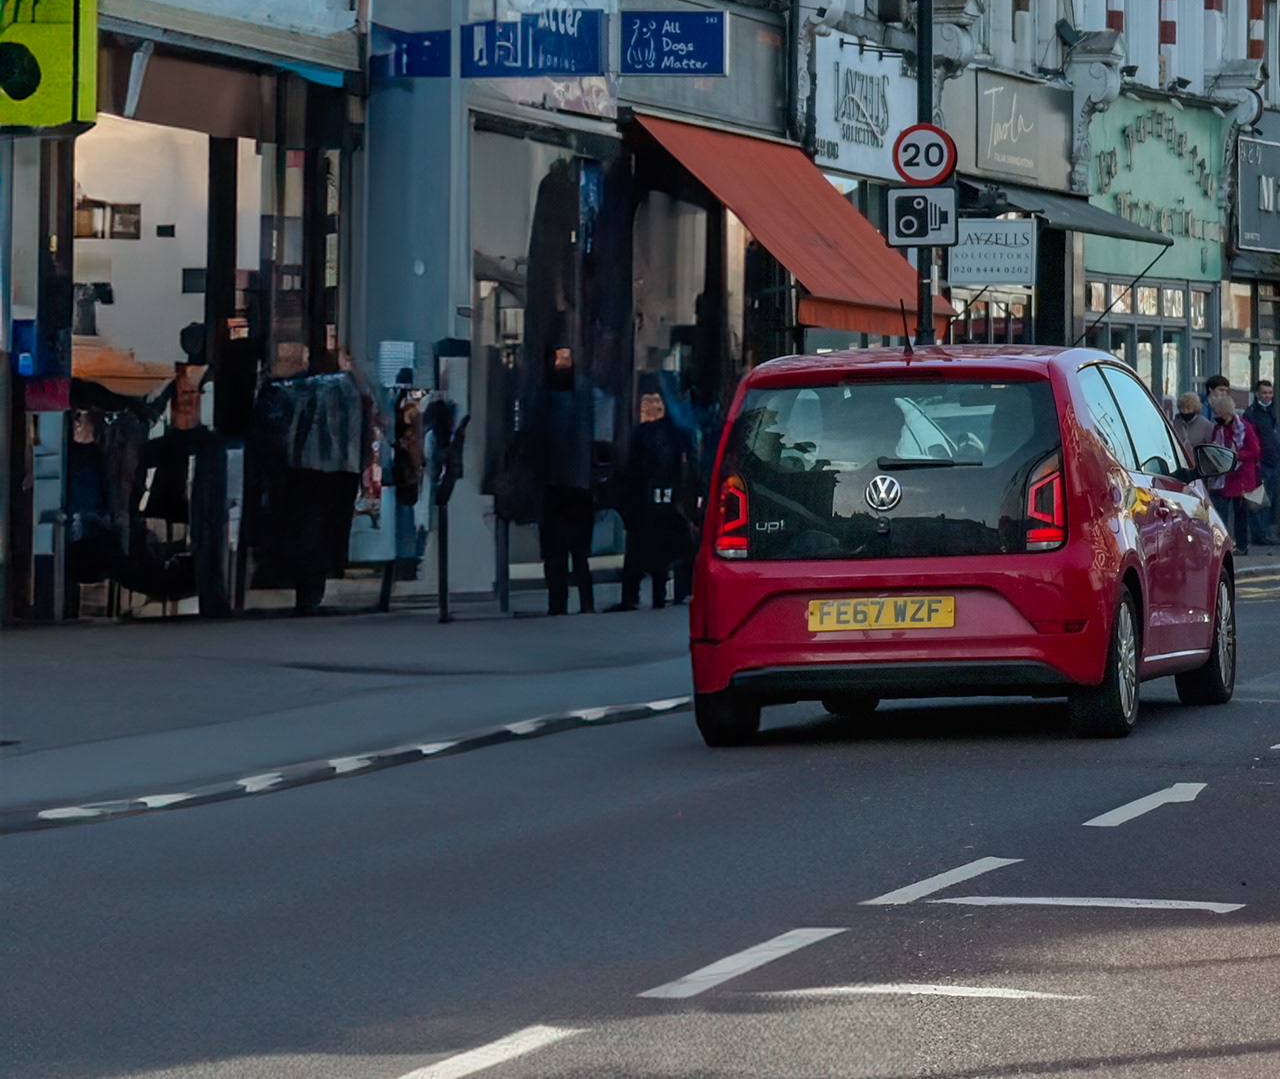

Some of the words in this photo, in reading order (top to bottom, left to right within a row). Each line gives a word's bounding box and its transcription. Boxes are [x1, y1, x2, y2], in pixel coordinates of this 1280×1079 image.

[662, 20, 680, 34] All
[705, 16, 718, 24] 243
[662, 37, 694, 55] Dogs
[661, 55, 709, 69] Matter
[841, 123, 884, 149] SOLICITORS
[902, 142, 944, 167] 20
[959, 232, 1030, 248] AYZELLS
[1004, 266, 1029, 274] 0202
[755, 520, 784, 533] up!
[818, 602, 885, 625] FE67
[893, 600, 943, 623] WZF
